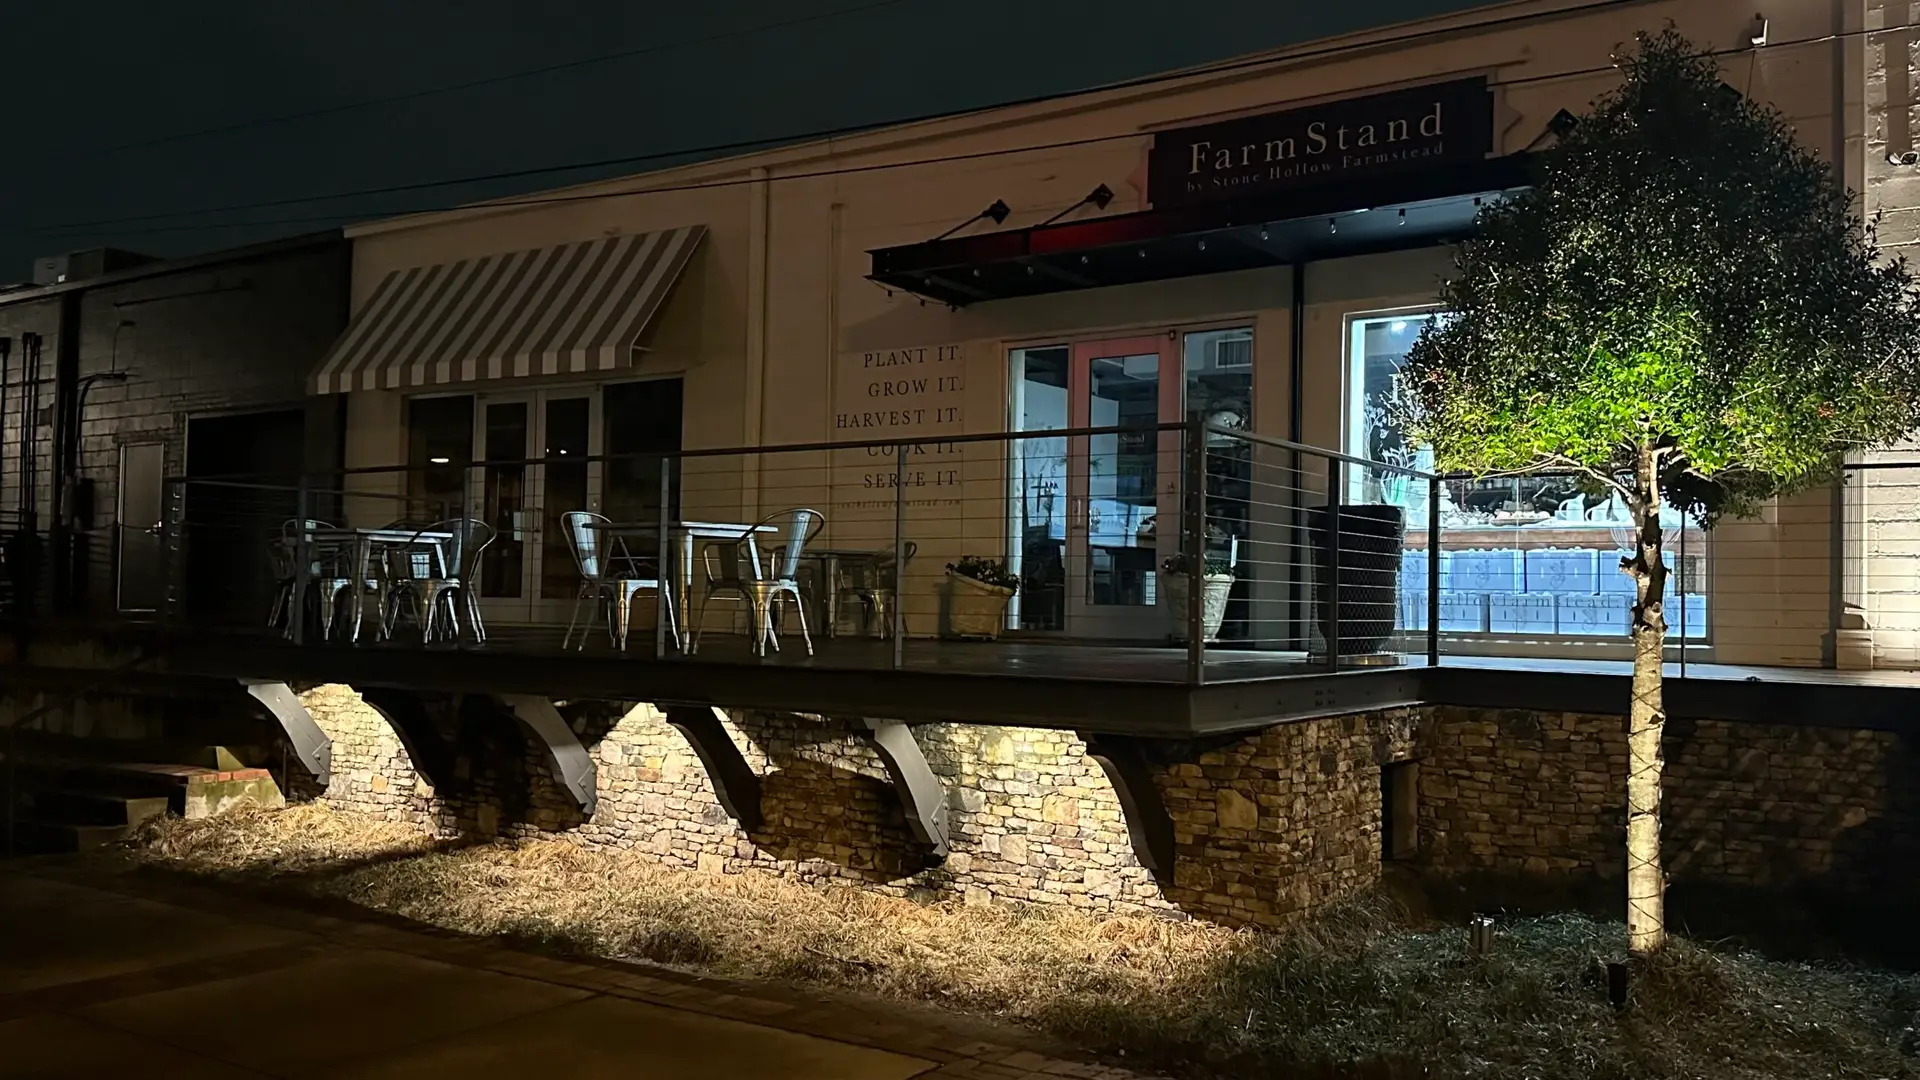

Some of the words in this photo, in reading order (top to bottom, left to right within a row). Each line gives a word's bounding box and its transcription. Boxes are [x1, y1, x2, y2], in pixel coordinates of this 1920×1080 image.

[1188, 102, 1444, 175] FarmStand
[1187, 180, 1204, 193] by
[1213, 173, 1259, 188] Stone
[1269, 162, 1331, 180] Hollow
[1342, 141, 1444, 168] Farmstead
[864, 348, 928, 368] PLANT
[937, 345, 963, 362] IT.
[868, 378, 928, 397] GROW
[938, 376, 963, 392] IT.
[836, 409, 926, 429] HARVEST
[936, 407, 963, 423] IT.
